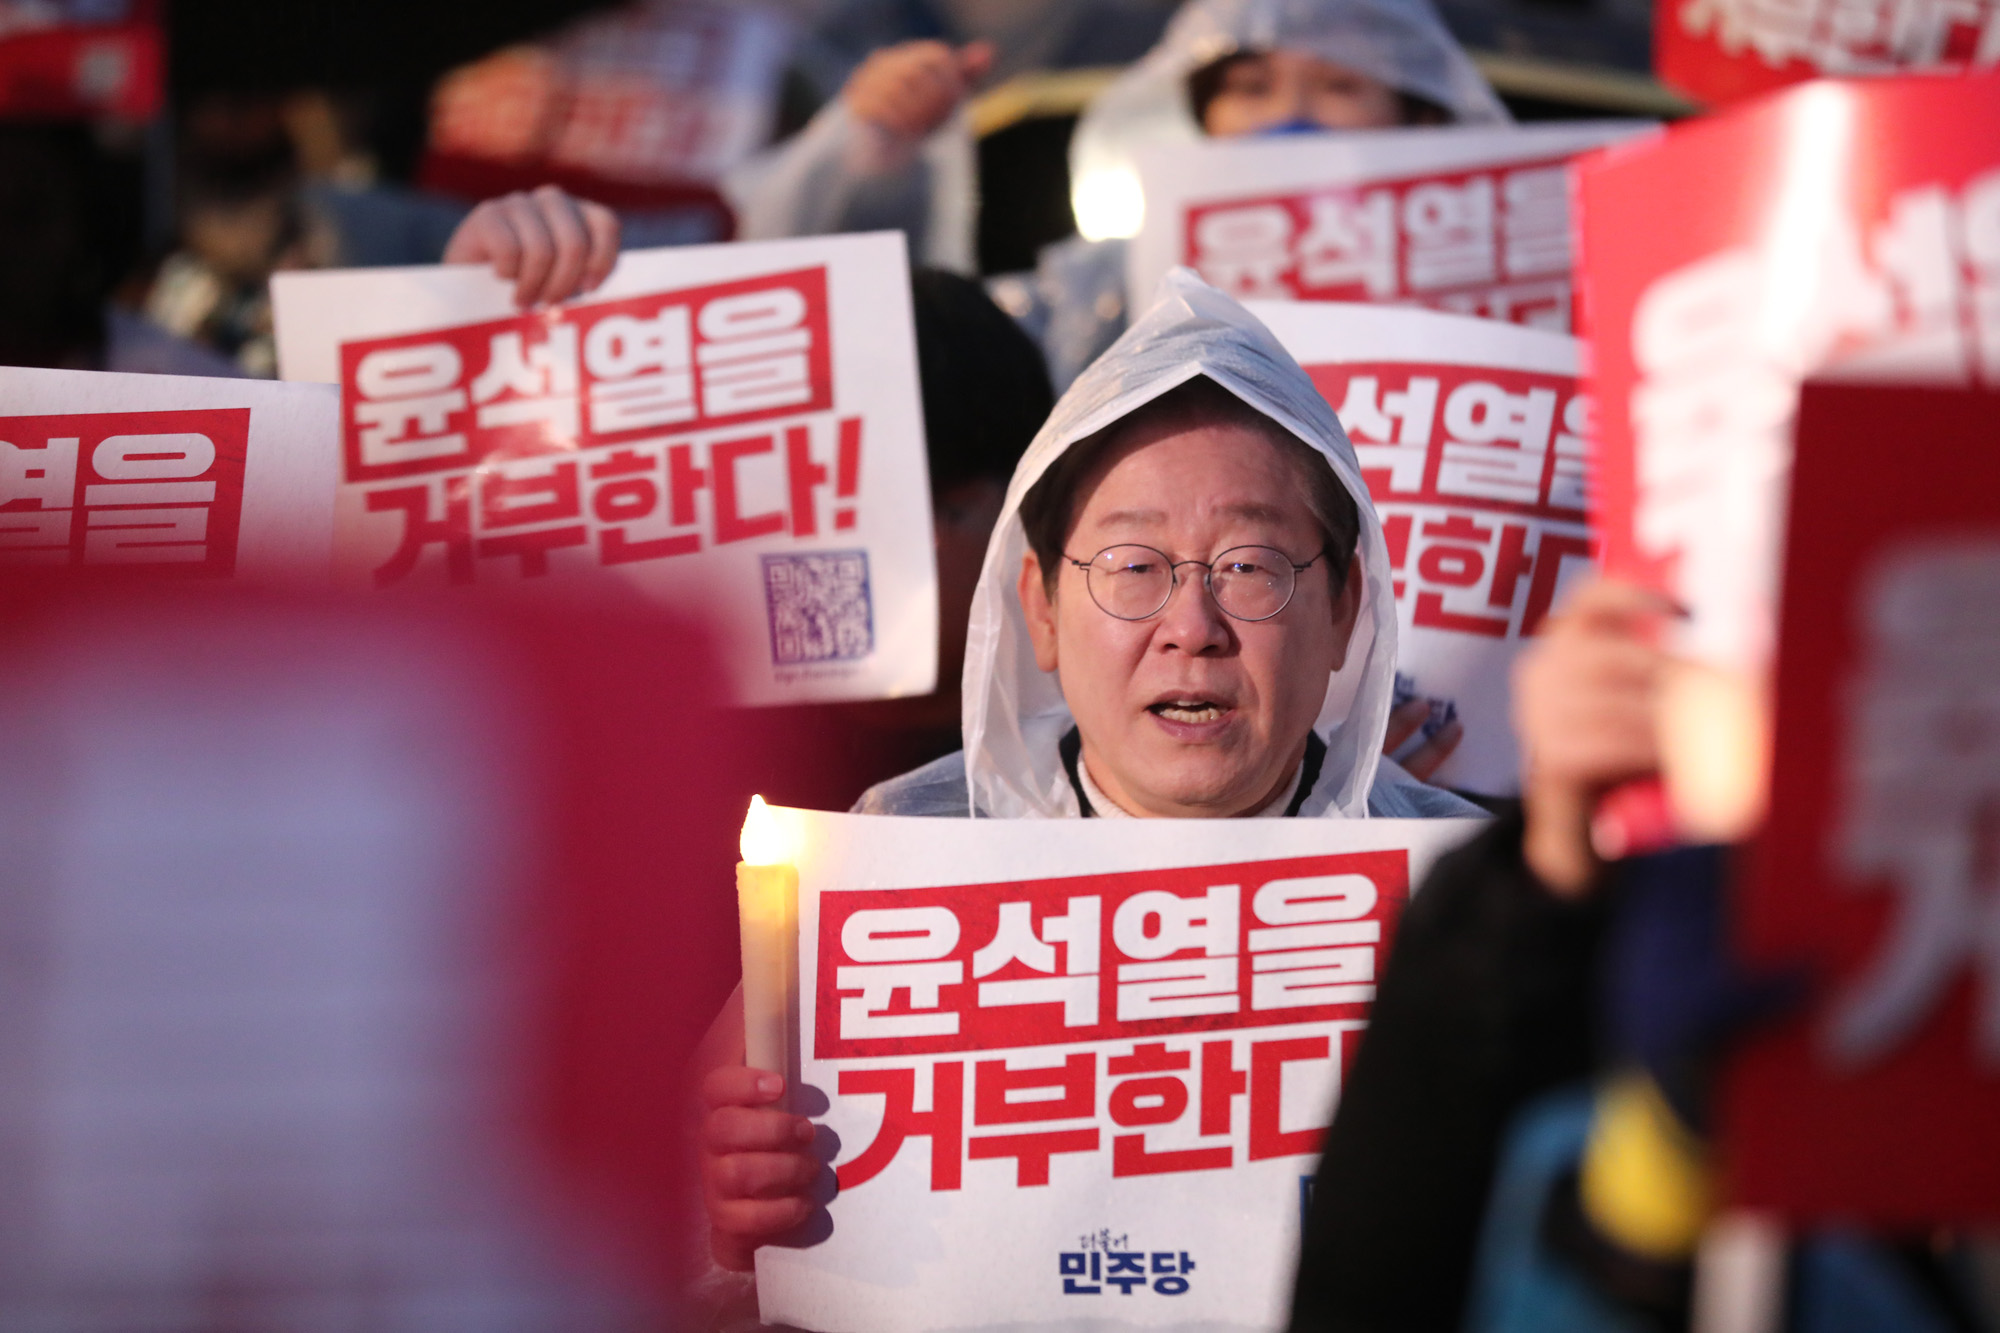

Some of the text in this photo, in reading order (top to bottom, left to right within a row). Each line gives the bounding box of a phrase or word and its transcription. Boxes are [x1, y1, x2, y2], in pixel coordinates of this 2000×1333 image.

[355, 287, 811, 466] 윤석열을
[1337, 376, 1588, 508] 석열
[365, 416, 862, 587] 거부한다!
[837, 874, 1380, 1039] 윤석열을
[1060, 1252, 1195, 1295] 민주당
